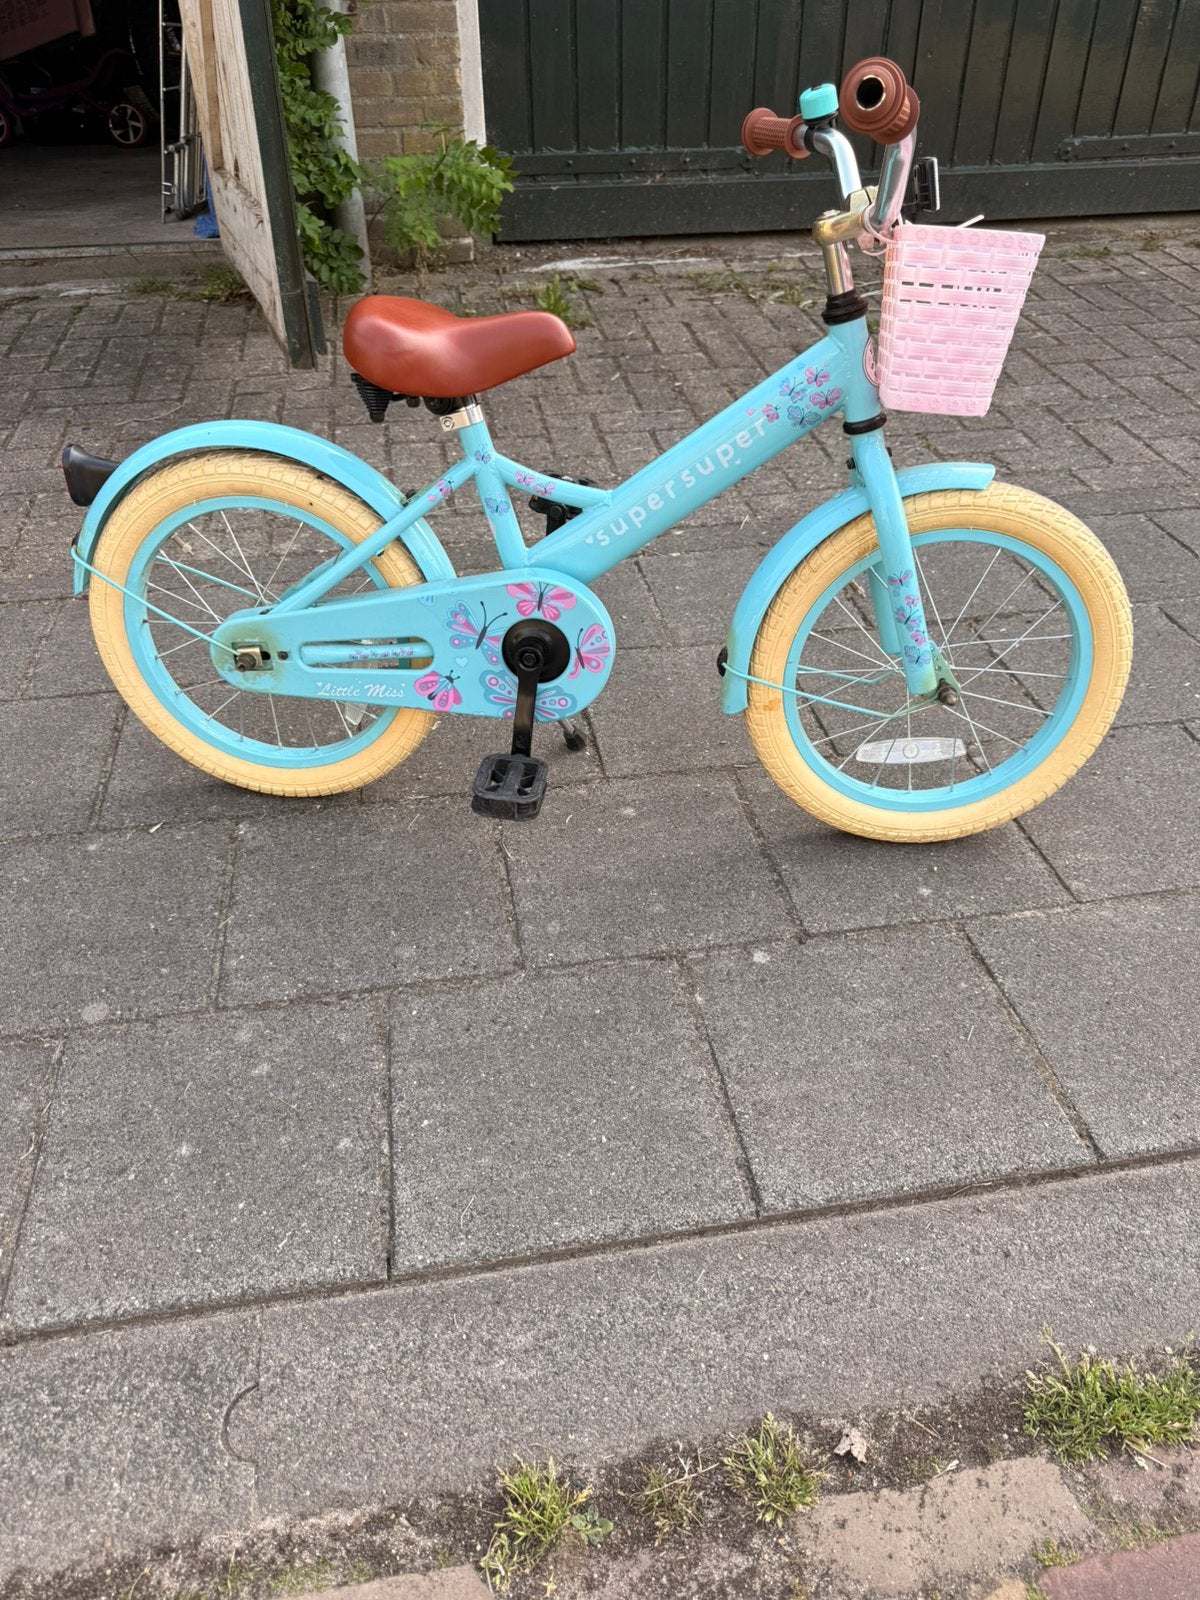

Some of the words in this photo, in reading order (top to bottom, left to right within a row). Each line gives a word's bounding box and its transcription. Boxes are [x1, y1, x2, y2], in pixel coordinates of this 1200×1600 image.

[595, 417, 766, 547] supersuper
[317, 683, 360, 697] Little
[364, 684, 405, 698] Miss
